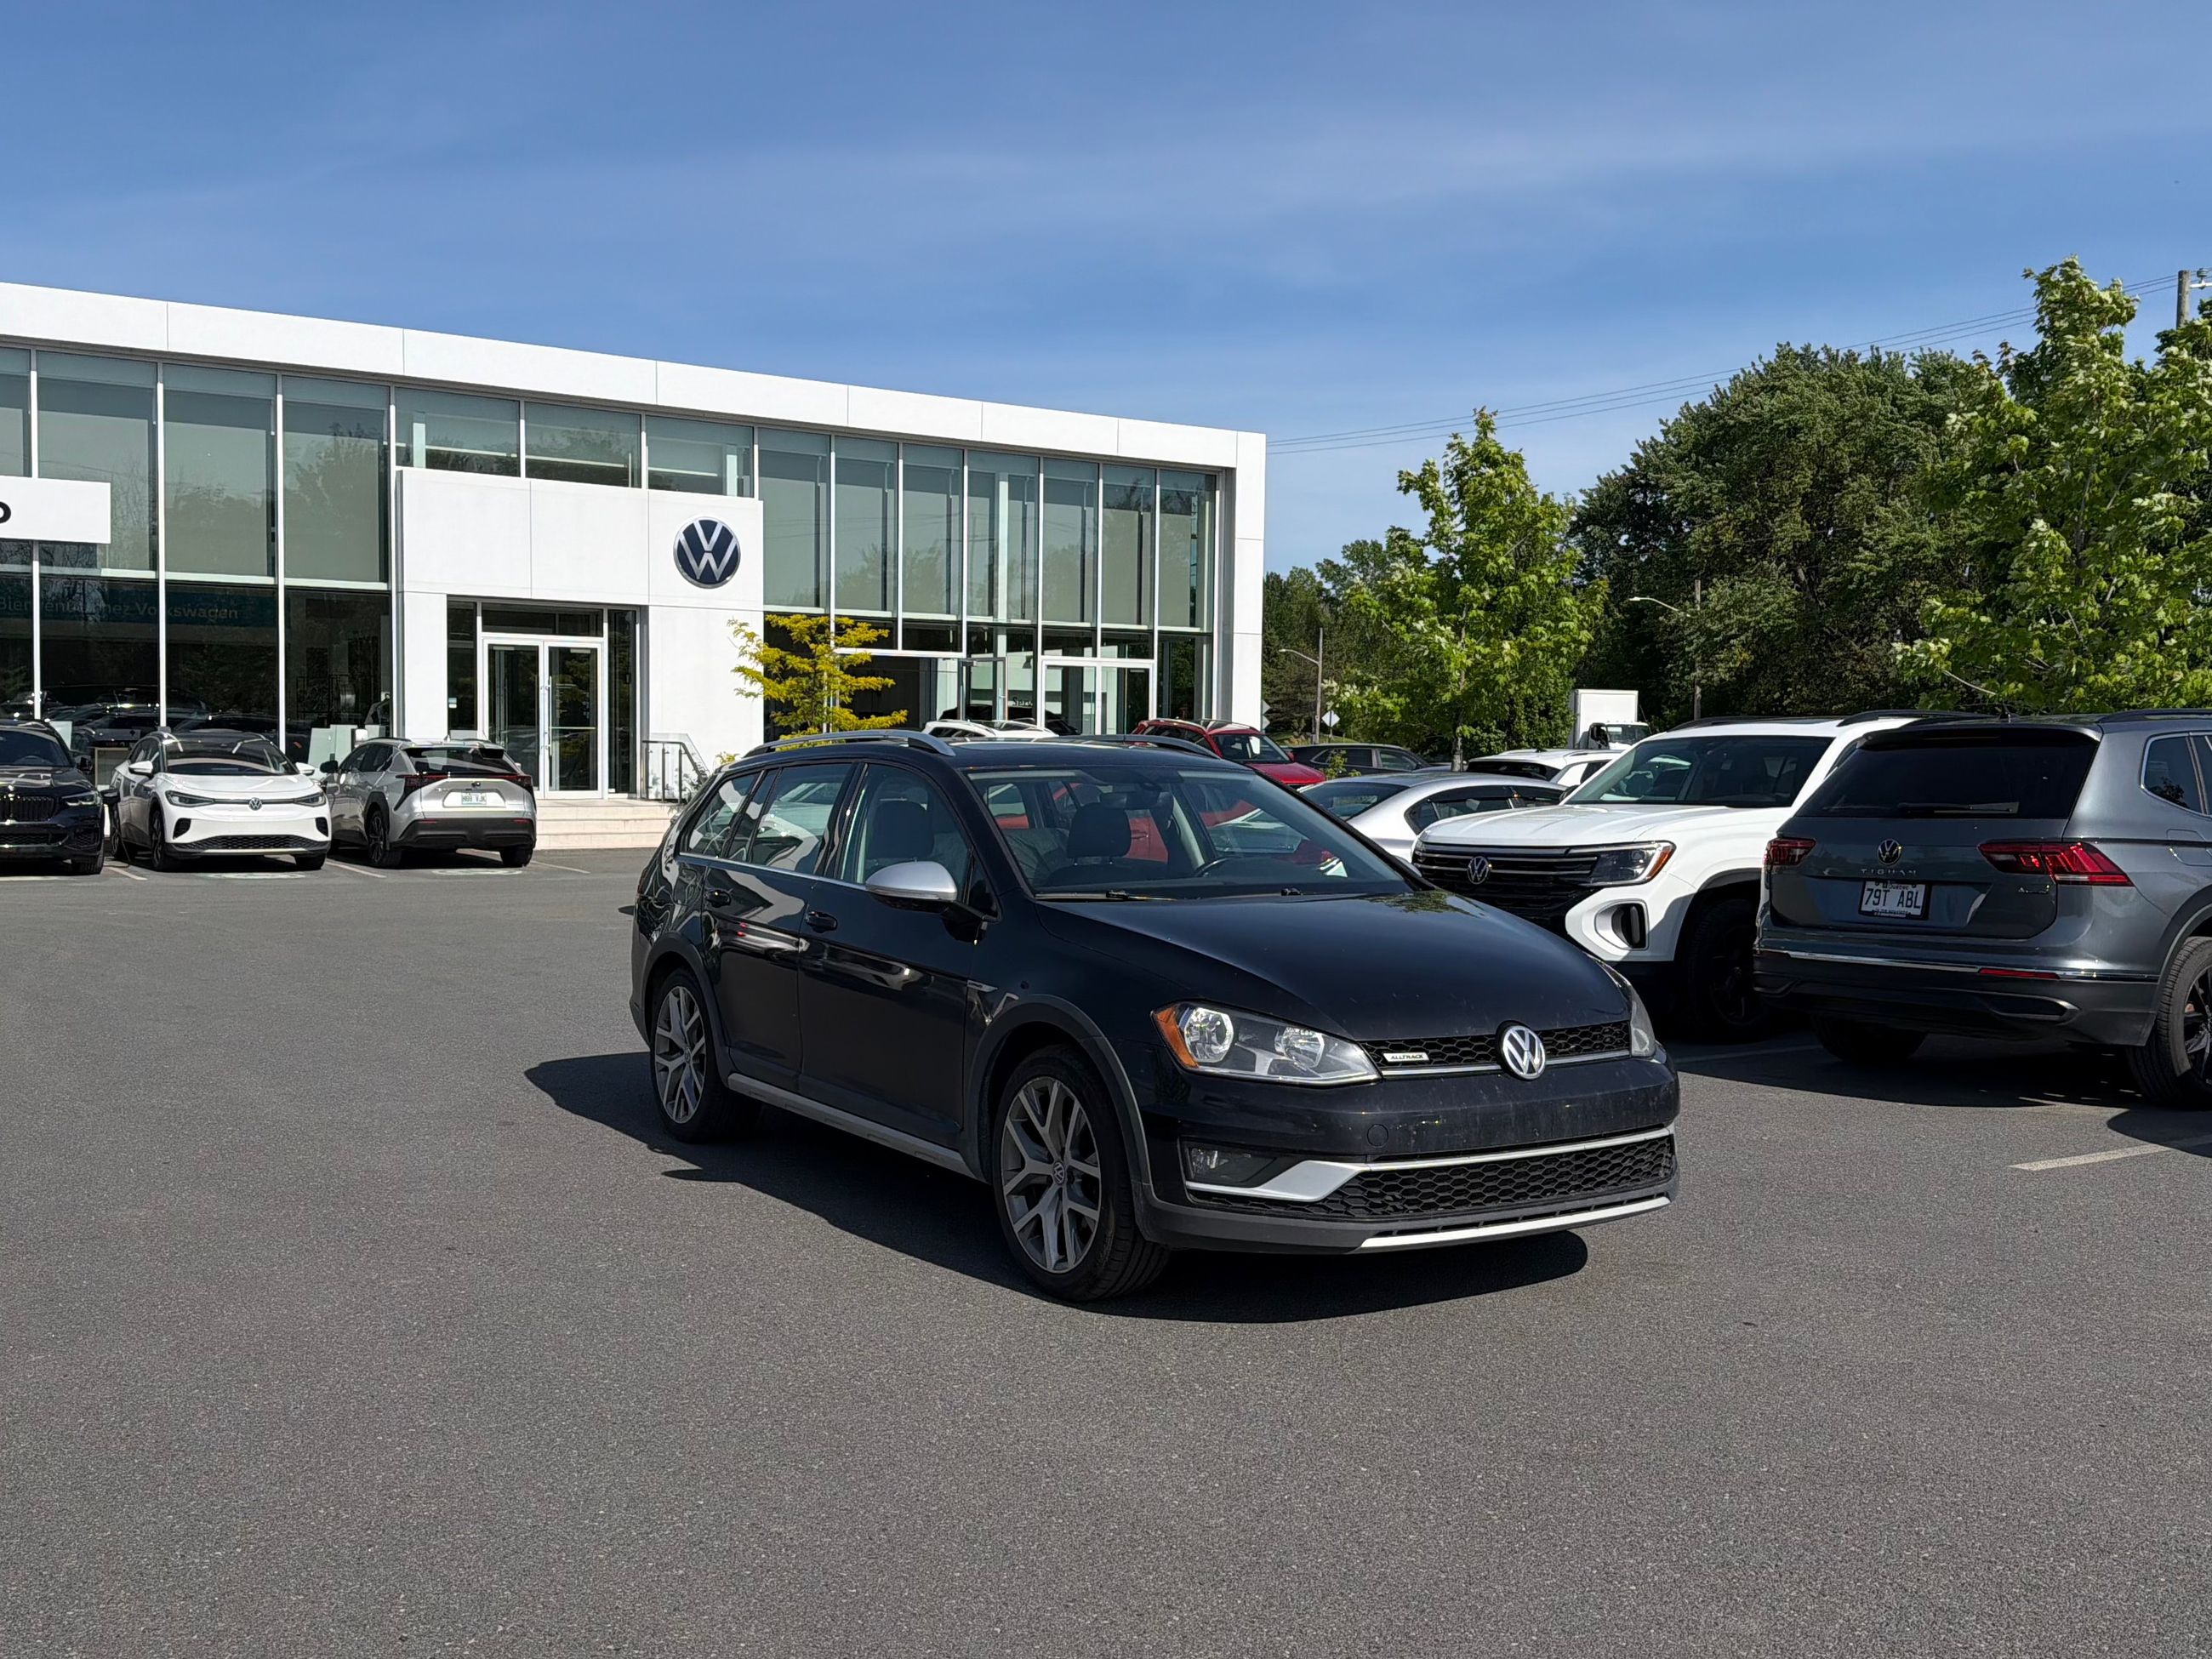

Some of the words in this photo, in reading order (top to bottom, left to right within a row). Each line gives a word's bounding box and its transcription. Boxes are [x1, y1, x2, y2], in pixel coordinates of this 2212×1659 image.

[135, 601, 238, 621] Vokswagen
[1864, 888, 1890, 907] 79T
[1896, 890, 1922, 909] ABL
